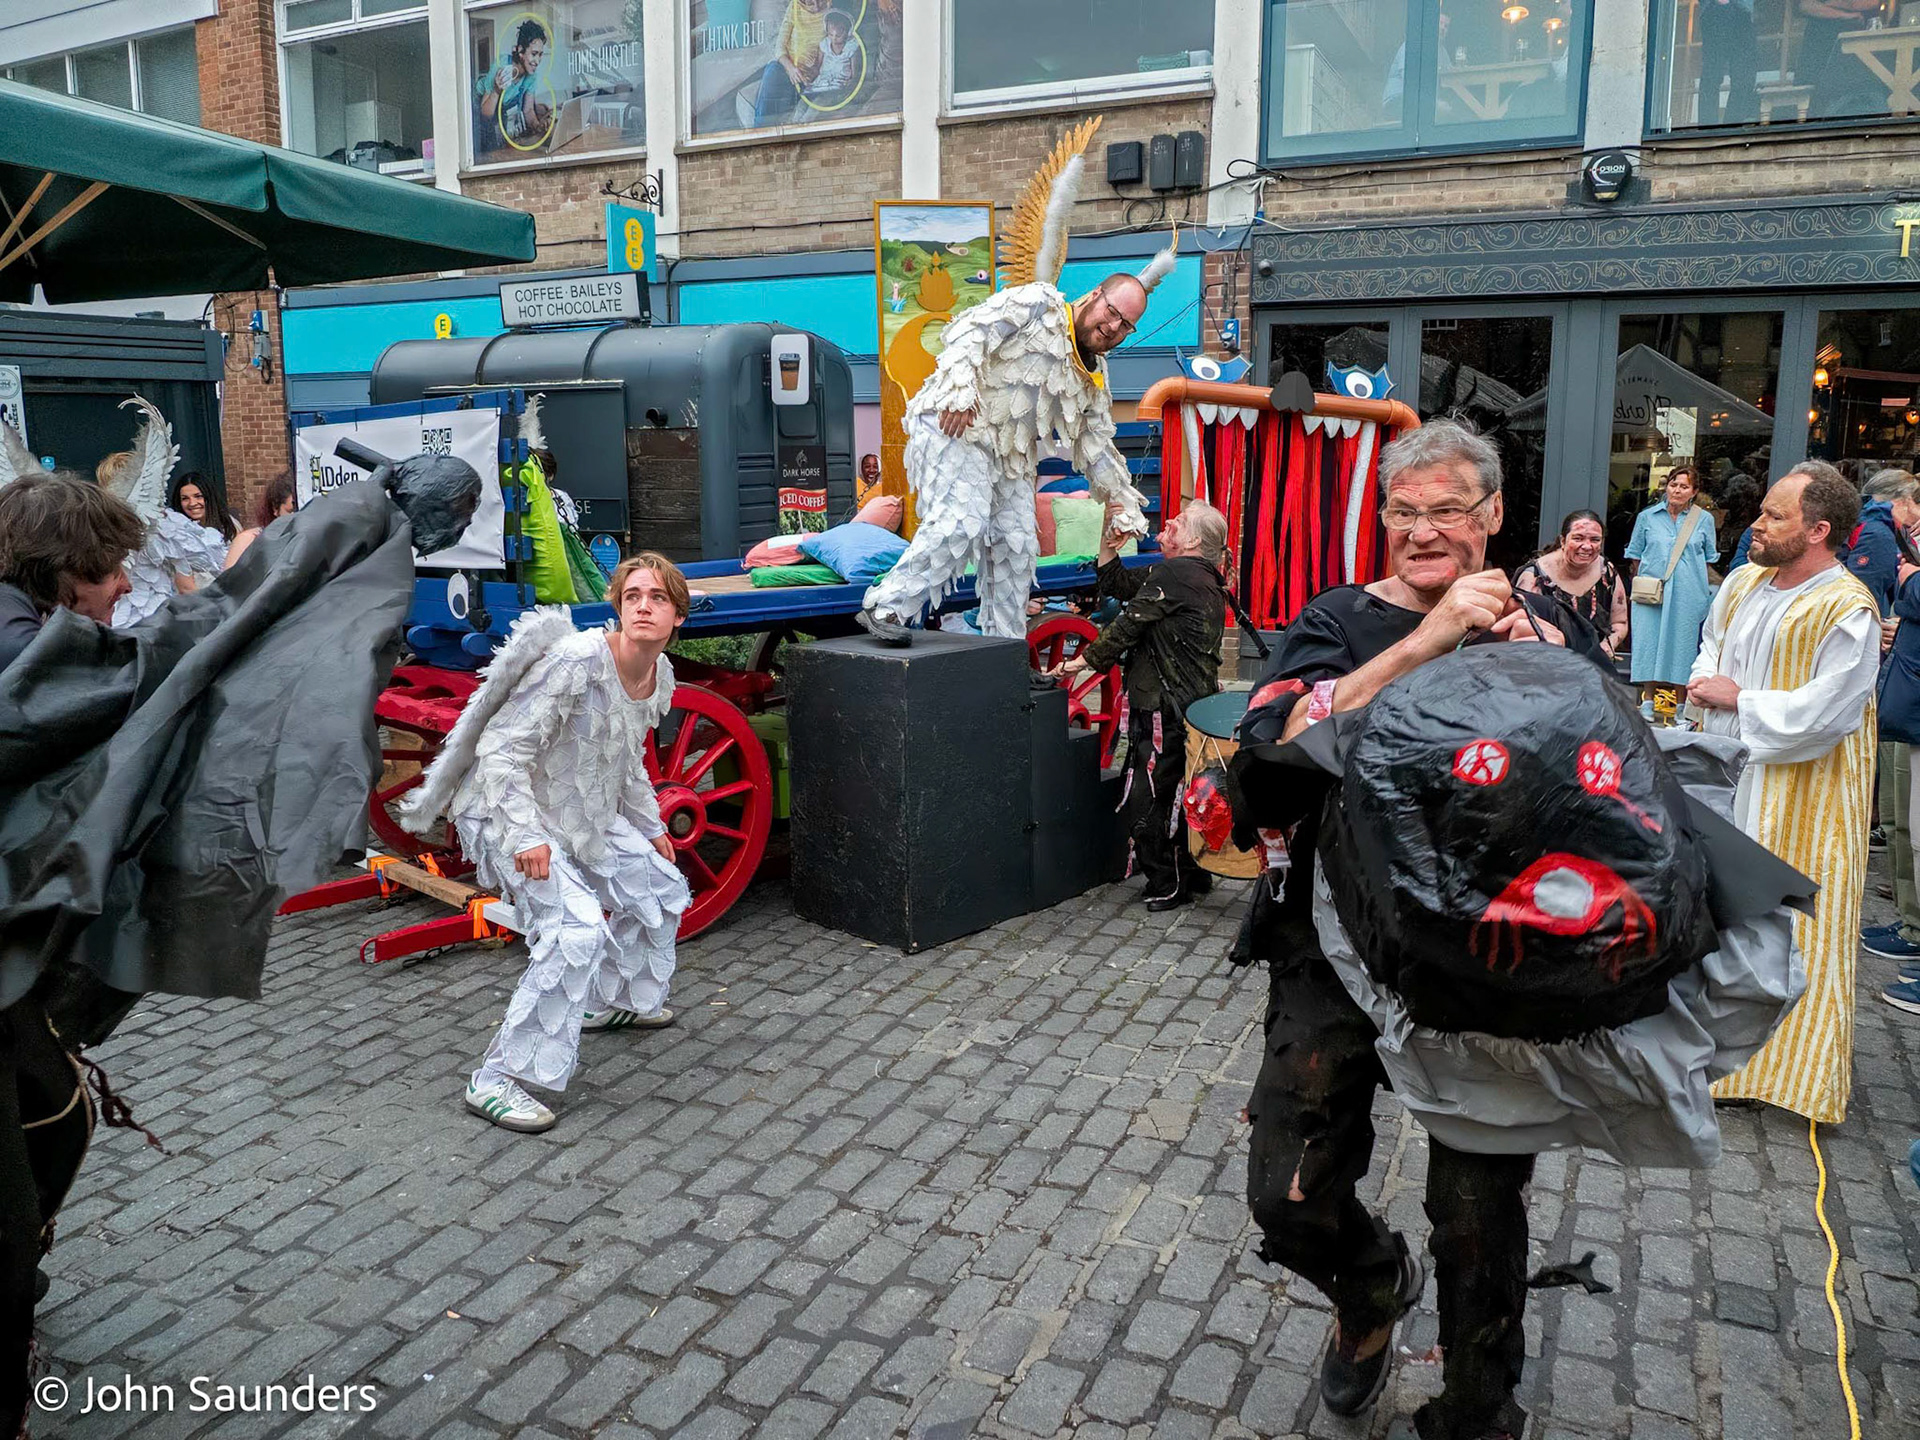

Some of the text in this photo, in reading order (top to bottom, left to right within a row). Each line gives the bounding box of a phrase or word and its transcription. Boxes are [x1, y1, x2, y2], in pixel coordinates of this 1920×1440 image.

[701, 19, 765, 54] THINK BIG
[567, 41, 639, 76] HOME HUSTLE
[515, 281, 623, 302] COFFEE BAILEYS
[518, 298, 622, 319] HOT CHOCOLATE
[782, 467, 820, 478] DARK HORSE
[779, 492, 826, 507] ICED COFFEE
